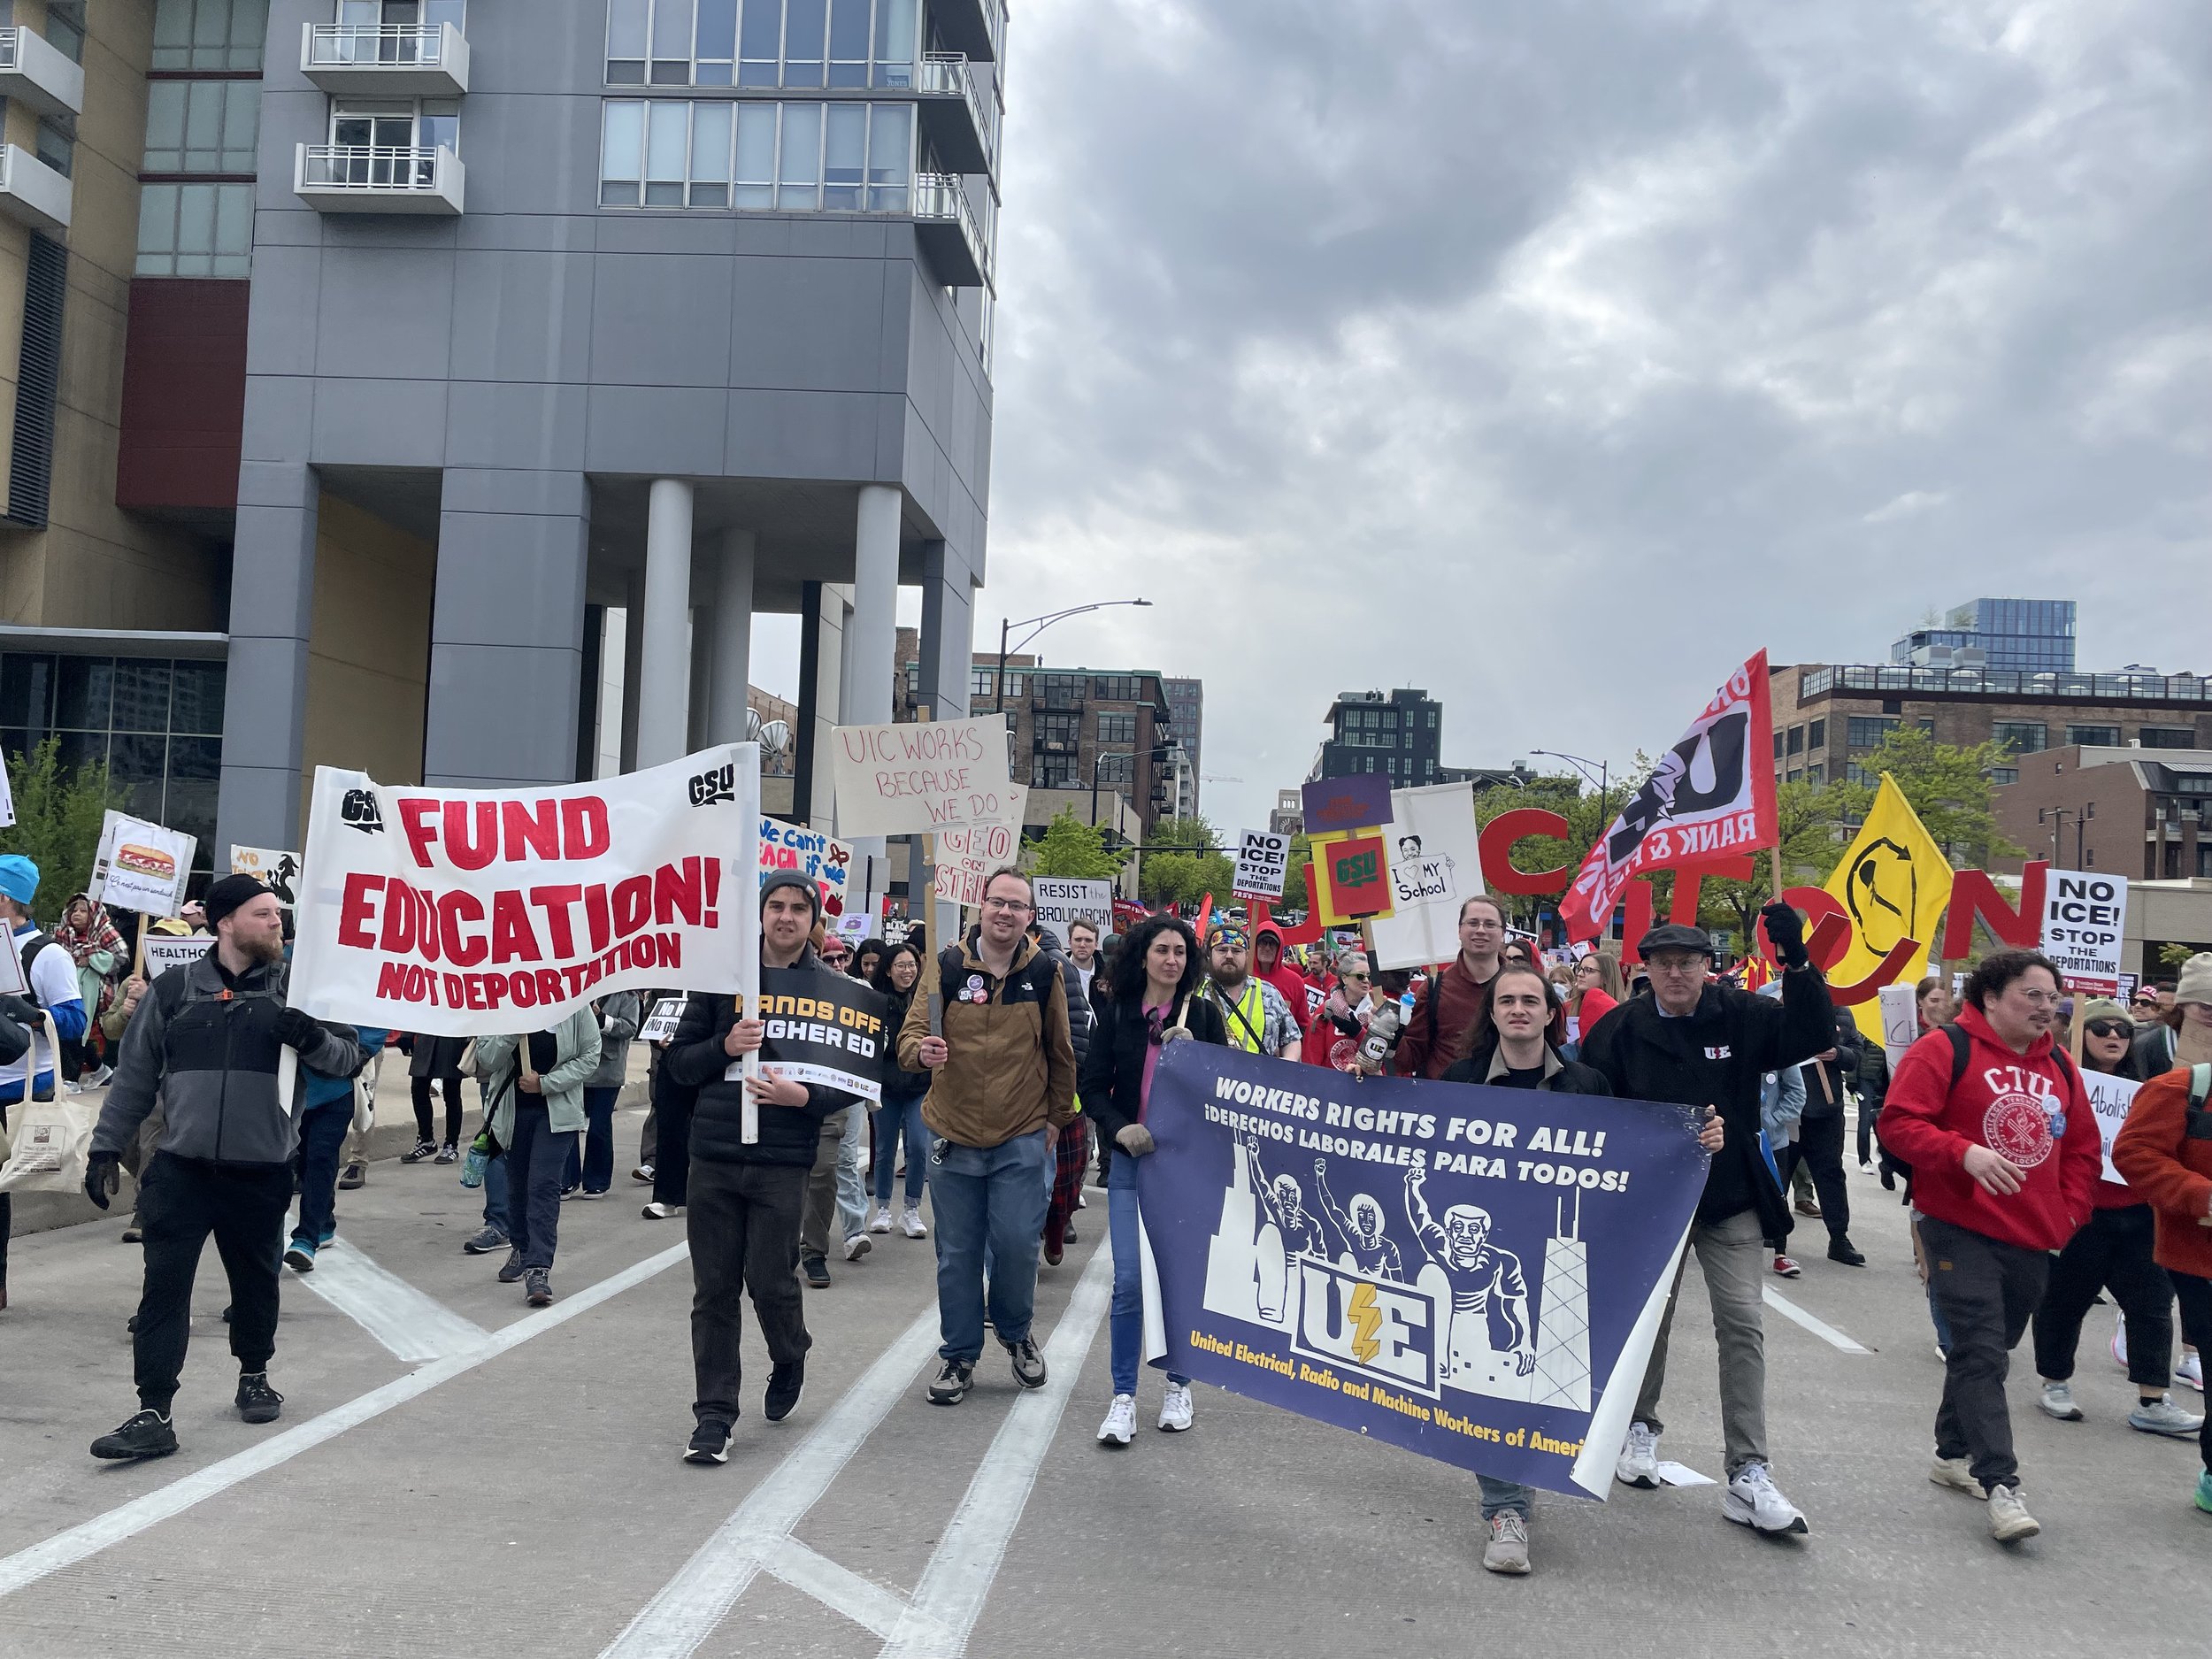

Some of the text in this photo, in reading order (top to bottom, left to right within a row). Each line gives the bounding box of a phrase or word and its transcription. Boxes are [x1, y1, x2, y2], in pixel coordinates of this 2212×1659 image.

[842, 727, 983, 763] UIC WORKS
[687, 762, 735, 806] GSU
[875, 767, 972, 797] BECAUSE
[924, 793, 999, 823] WE DO
[397, 795, 611, 871] FUND
[943, 826, 1011, 860] GEO
[1246, 833, 1283, 850] NO
[805, 854, 821, 878] if
[961, 856, 986, 872] ON
[1240, 847, 1286, 865] ICE!
[1335, 849, 1378, 885] GSU
[822, 864, 847, 886] we
[1239, 863, 1282, 876] STOP
[1249, 873, 1270, 882] THE
[1391, 863, 1440, 884] I MY
[934, 864, 987, 904] STRI
[1039, 884, 1087, 900] RESIST
[1236, 878, 1282, 893] DEPORTATIONS
[1398, 876, 1447, 901] School
[2058, 877, 2116, 902] NO
[338, 856, 720, 968] EDUCATION!
[1036, 905, 1111, 926] BROLIGARCHY
[2050, 901, 2121, 927] ICE!
[2050, 927, 2116, 946] STOP
[151, 946, 207, 959] HEALTHC
[2068, 946, 2098, 957] THE
[375, 932, 681, 1010] NOT DEPORTATION
[2048, 955, 2116, 974] DEPORTATIONS
[657, 1002, 675, 1017] No
[839, 1006, 881, 1035] OFF
[740, 1019, 876, 1059] IGHER ED
[1983, 1064, 2054, 1101] CTU
[1215, 1076, 1608, 1158] WORKERS RIGHTS FOR ALL!
[1298, 1128, 1427, 1169] LABORALES
[1433, 1150, 1507, 1179] PARA
[1517, 1160, 1631, 1194] TODOS!
[1190, 1330, 1586, 1458] United Electrical, Radio and Machine Workers of Ameri
